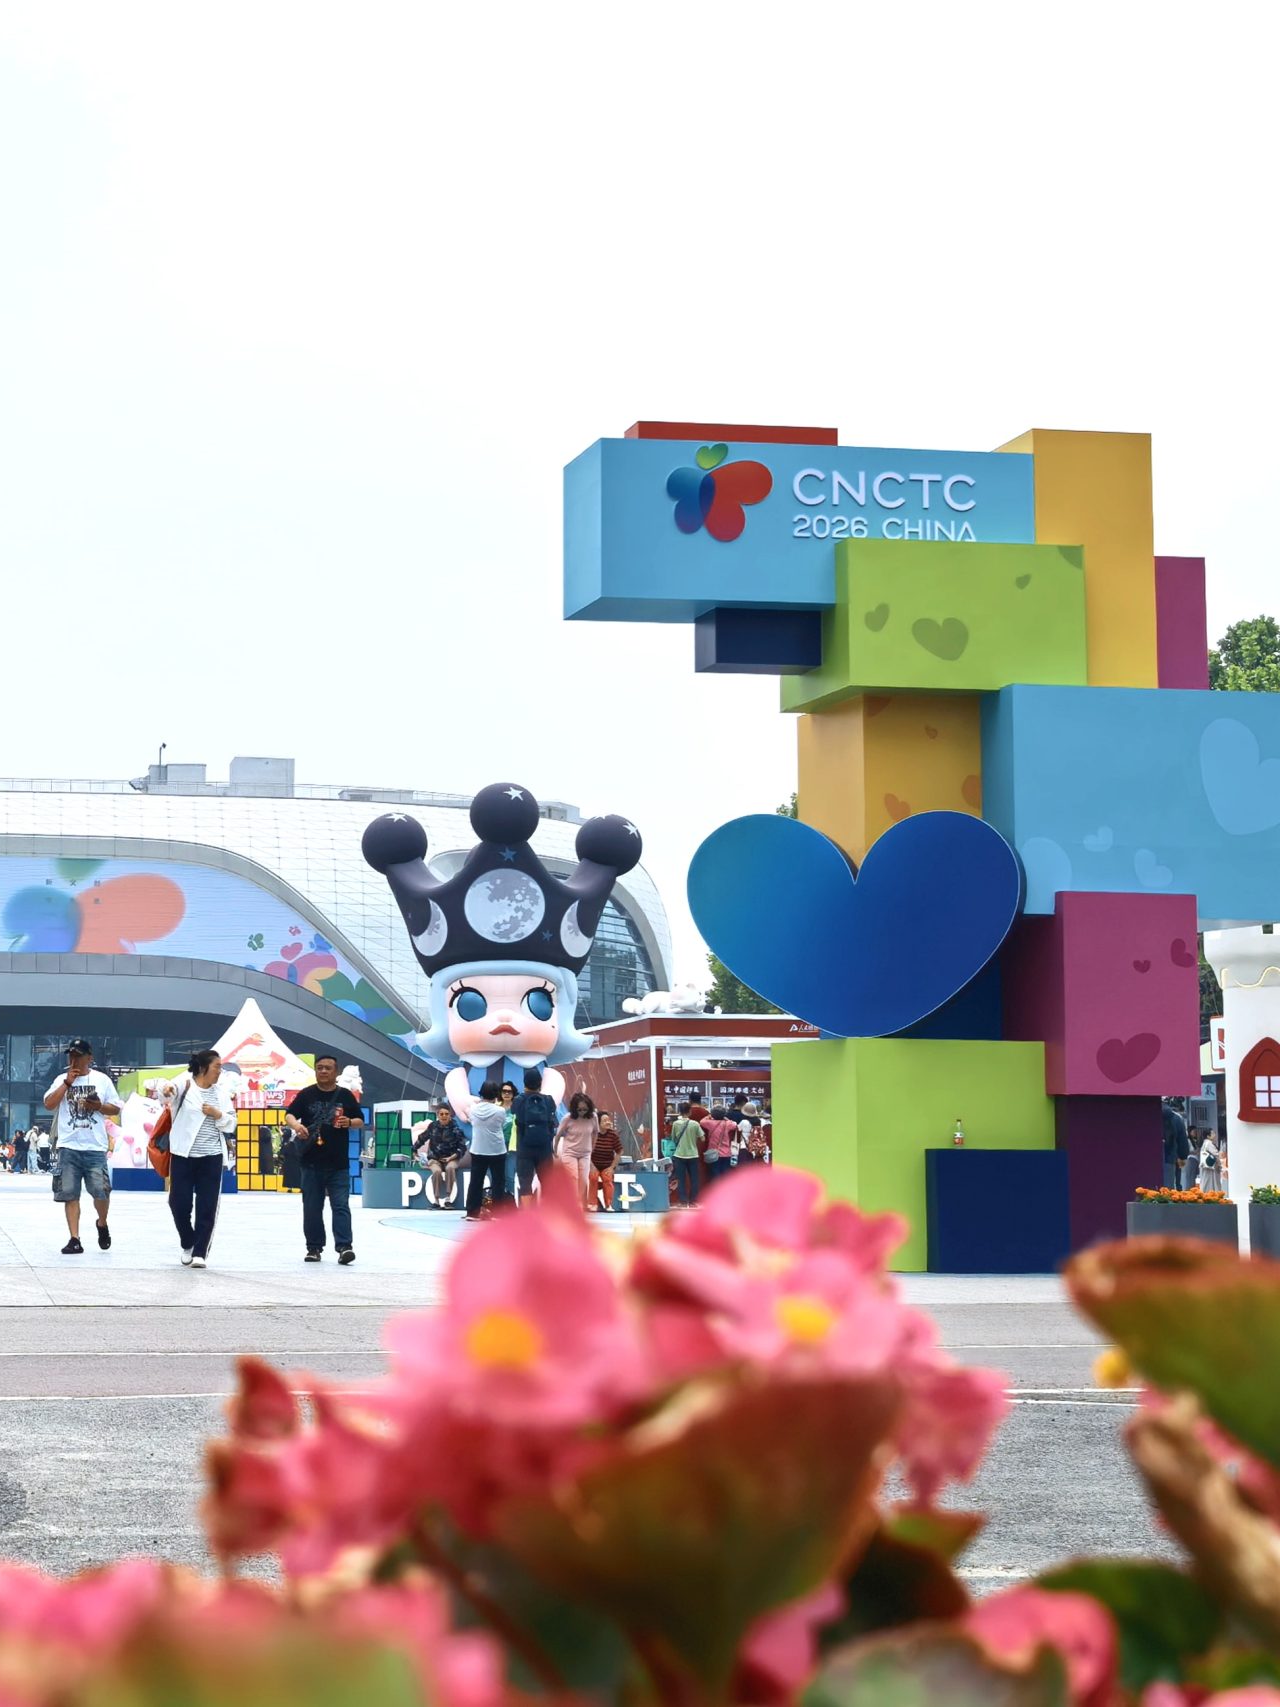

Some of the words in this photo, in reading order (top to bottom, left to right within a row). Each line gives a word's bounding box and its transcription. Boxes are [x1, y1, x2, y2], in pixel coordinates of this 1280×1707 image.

[792, 468, 977, 512] CNCTC
[792, 514, 869, 539] 2026
[881, 517, 977, 542] CHINA
